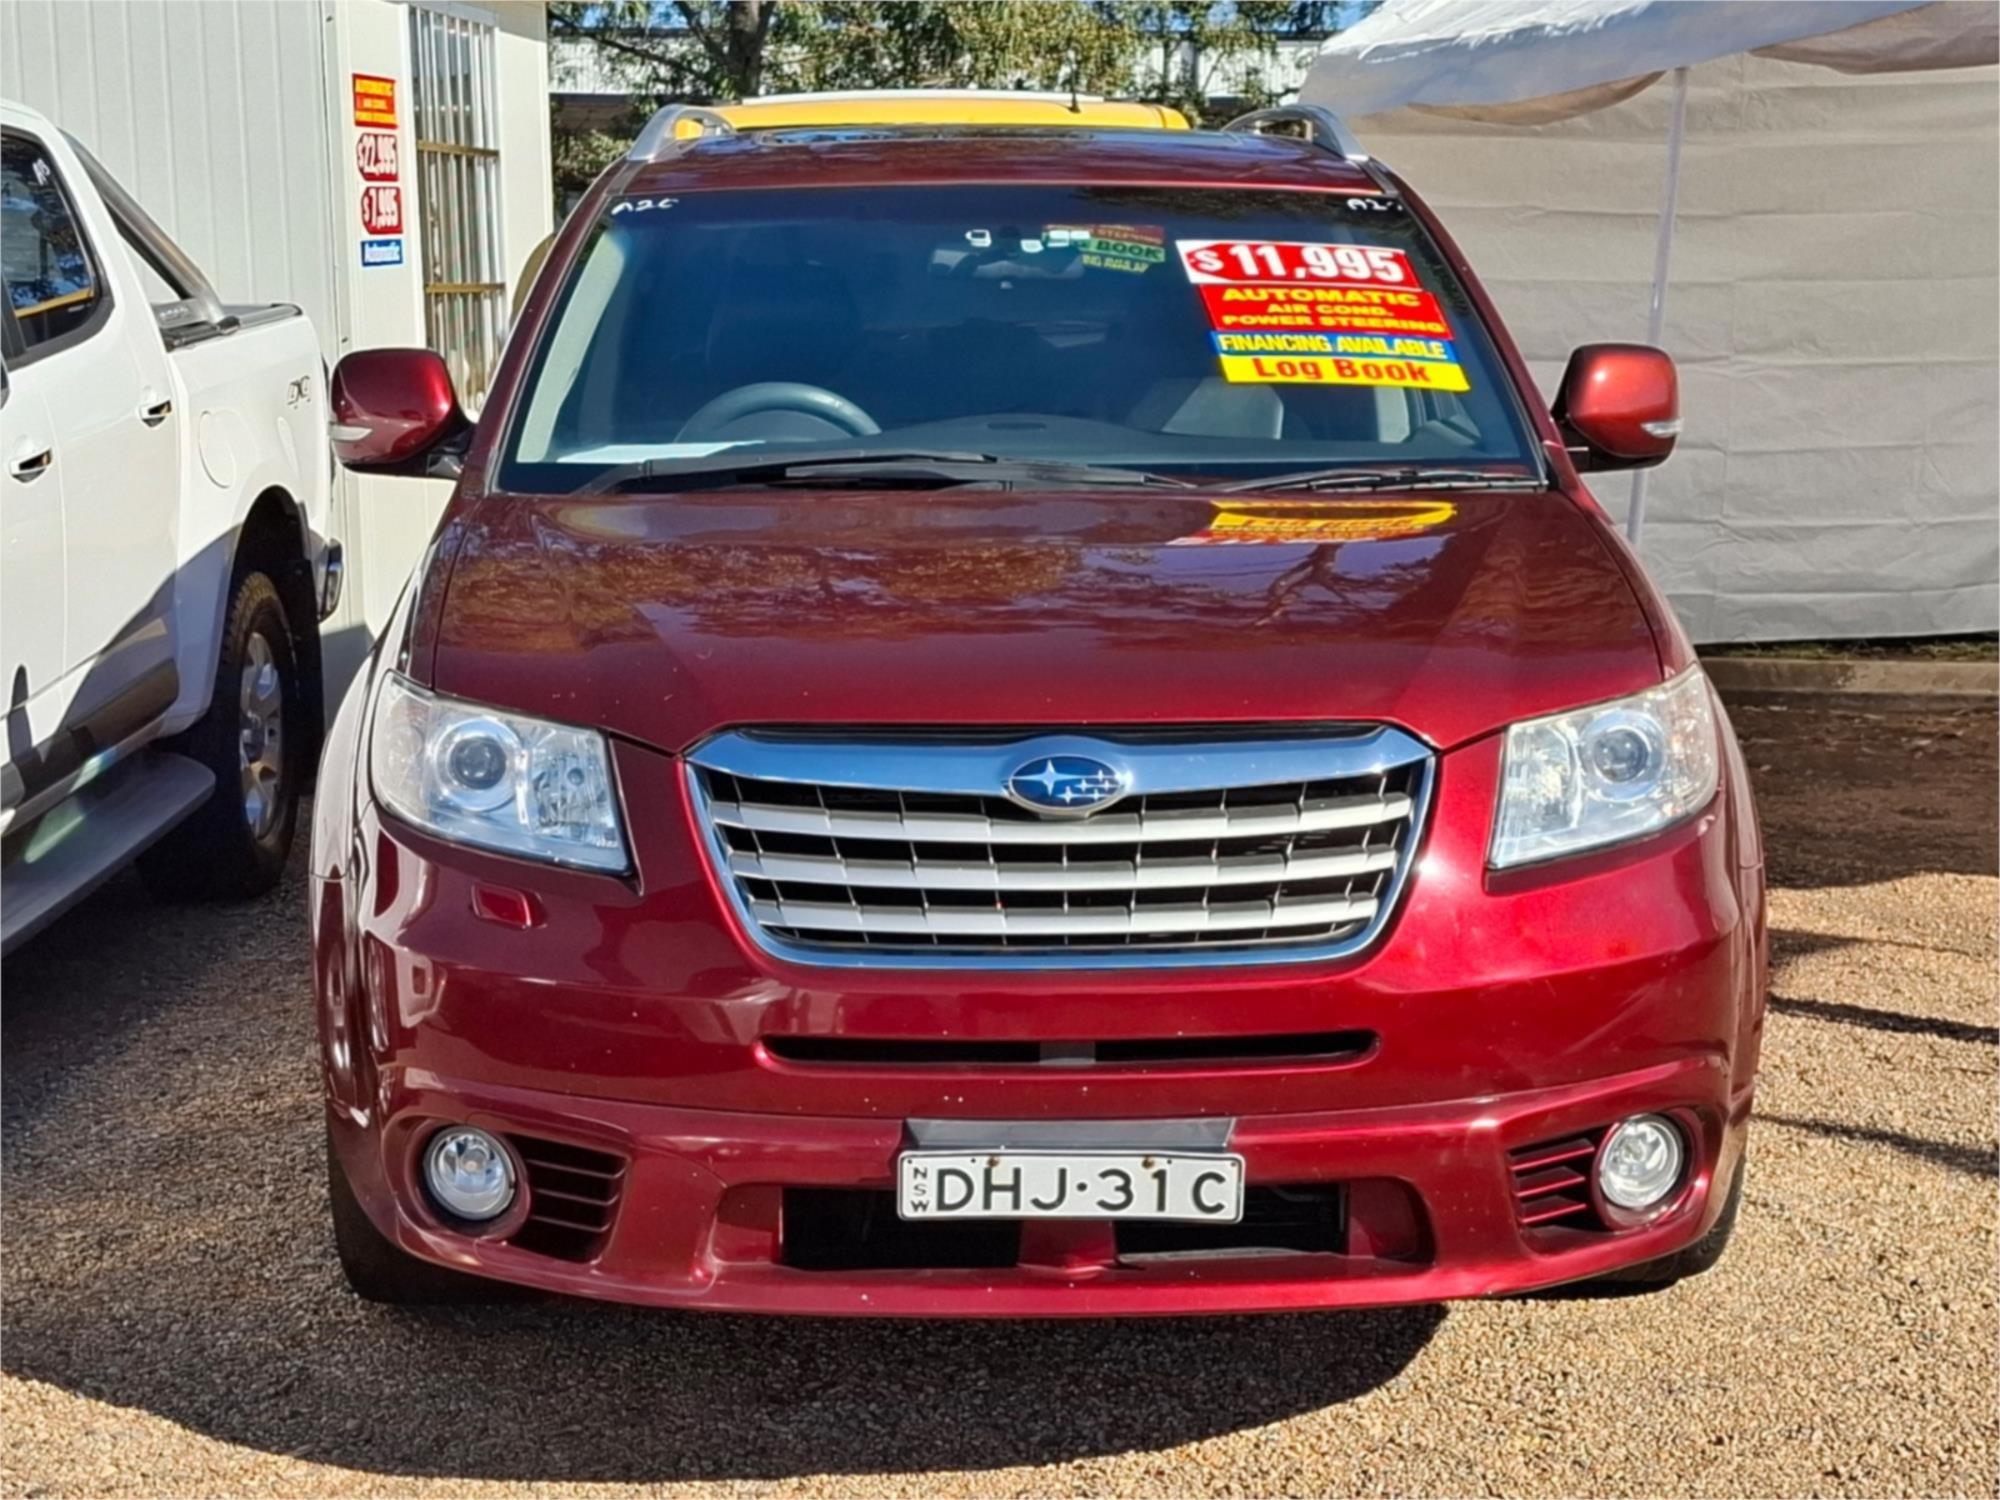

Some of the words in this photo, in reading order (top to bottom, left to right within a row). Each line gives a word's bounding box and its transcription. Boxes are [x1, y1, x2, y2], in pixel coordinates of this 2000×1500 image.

[1097, 240, 1162, 260] BOOK
[1222, 288, 1421, 307] AUTOMATIC
[1267, 303, 1311, 315] AIR
[1316, 304, 1394, 317] COND.
[1222, 314, 1317, 326] POWER
[1319, 316, 1447, 333] STEERING
[1219, 335, 1332, 352] FINANCING
[1337, 337, 1448, 359] AVAILABLE
[1255, 358, 1323, 381] Log
[1334, 359, 1431, 383] Book
[911, 1167, 929, 1213] NSW
